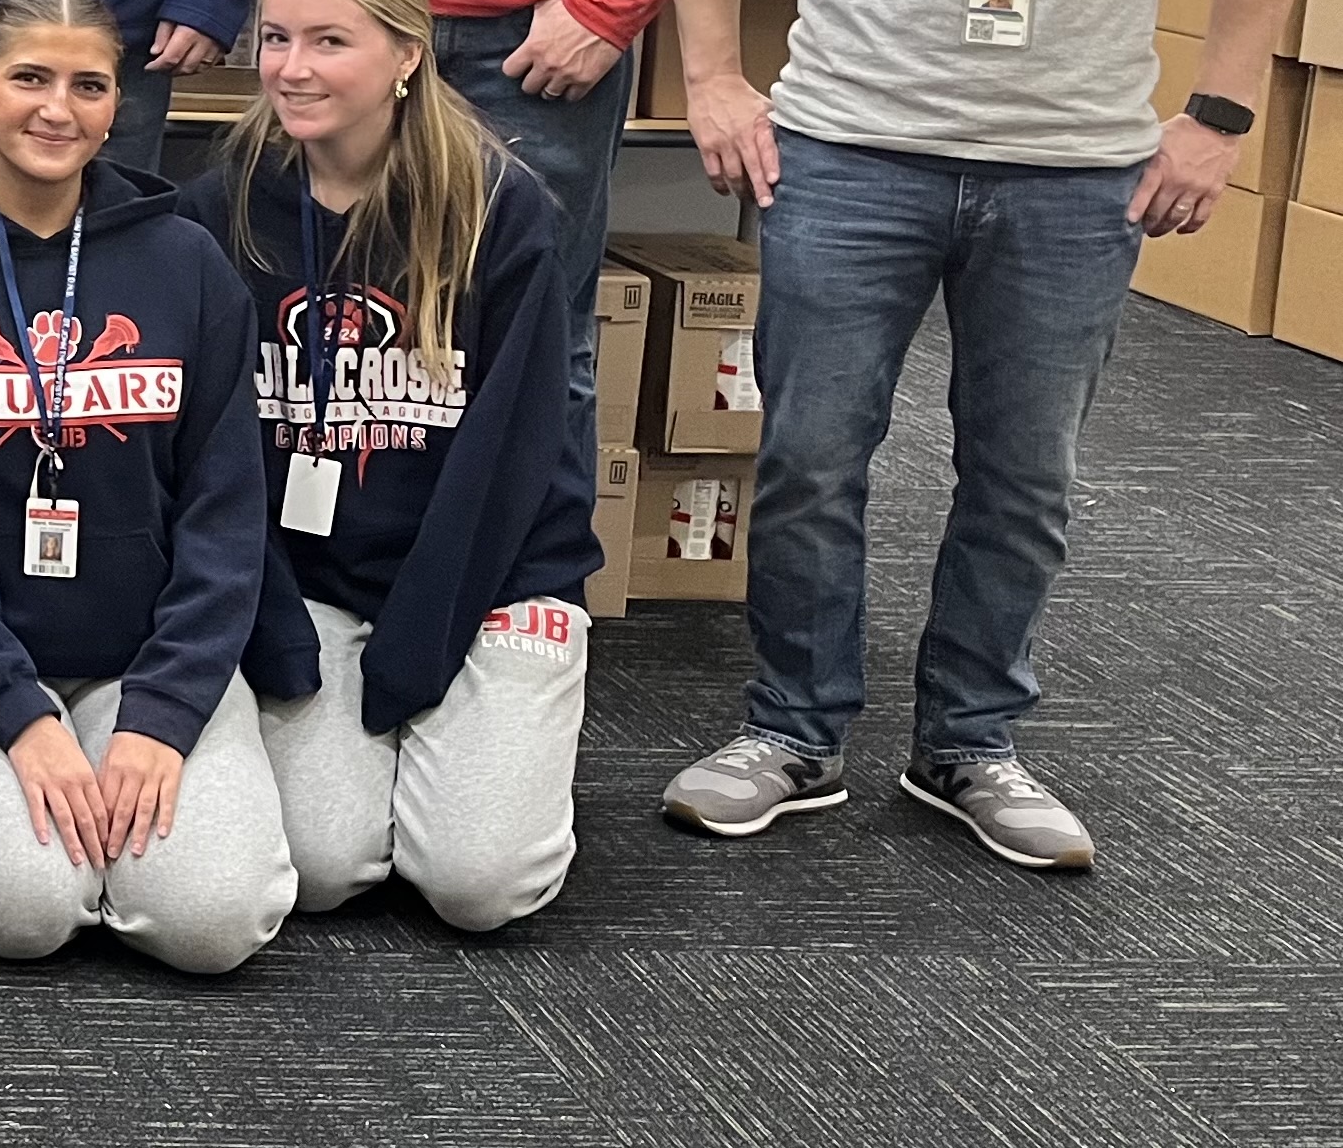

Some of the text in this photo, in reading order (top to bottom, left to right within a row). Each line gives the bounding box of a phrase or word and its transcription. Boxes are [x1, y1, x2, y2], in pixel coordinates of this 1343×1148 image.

[692, 292, 745, 306] FRAGILE
[323, 327, 360, 341] 224
[286, 345, 466, 407] LCROSE
[275, 423, 426, 452] CAMPIONS
[482, 603, 570, 645] SJB
